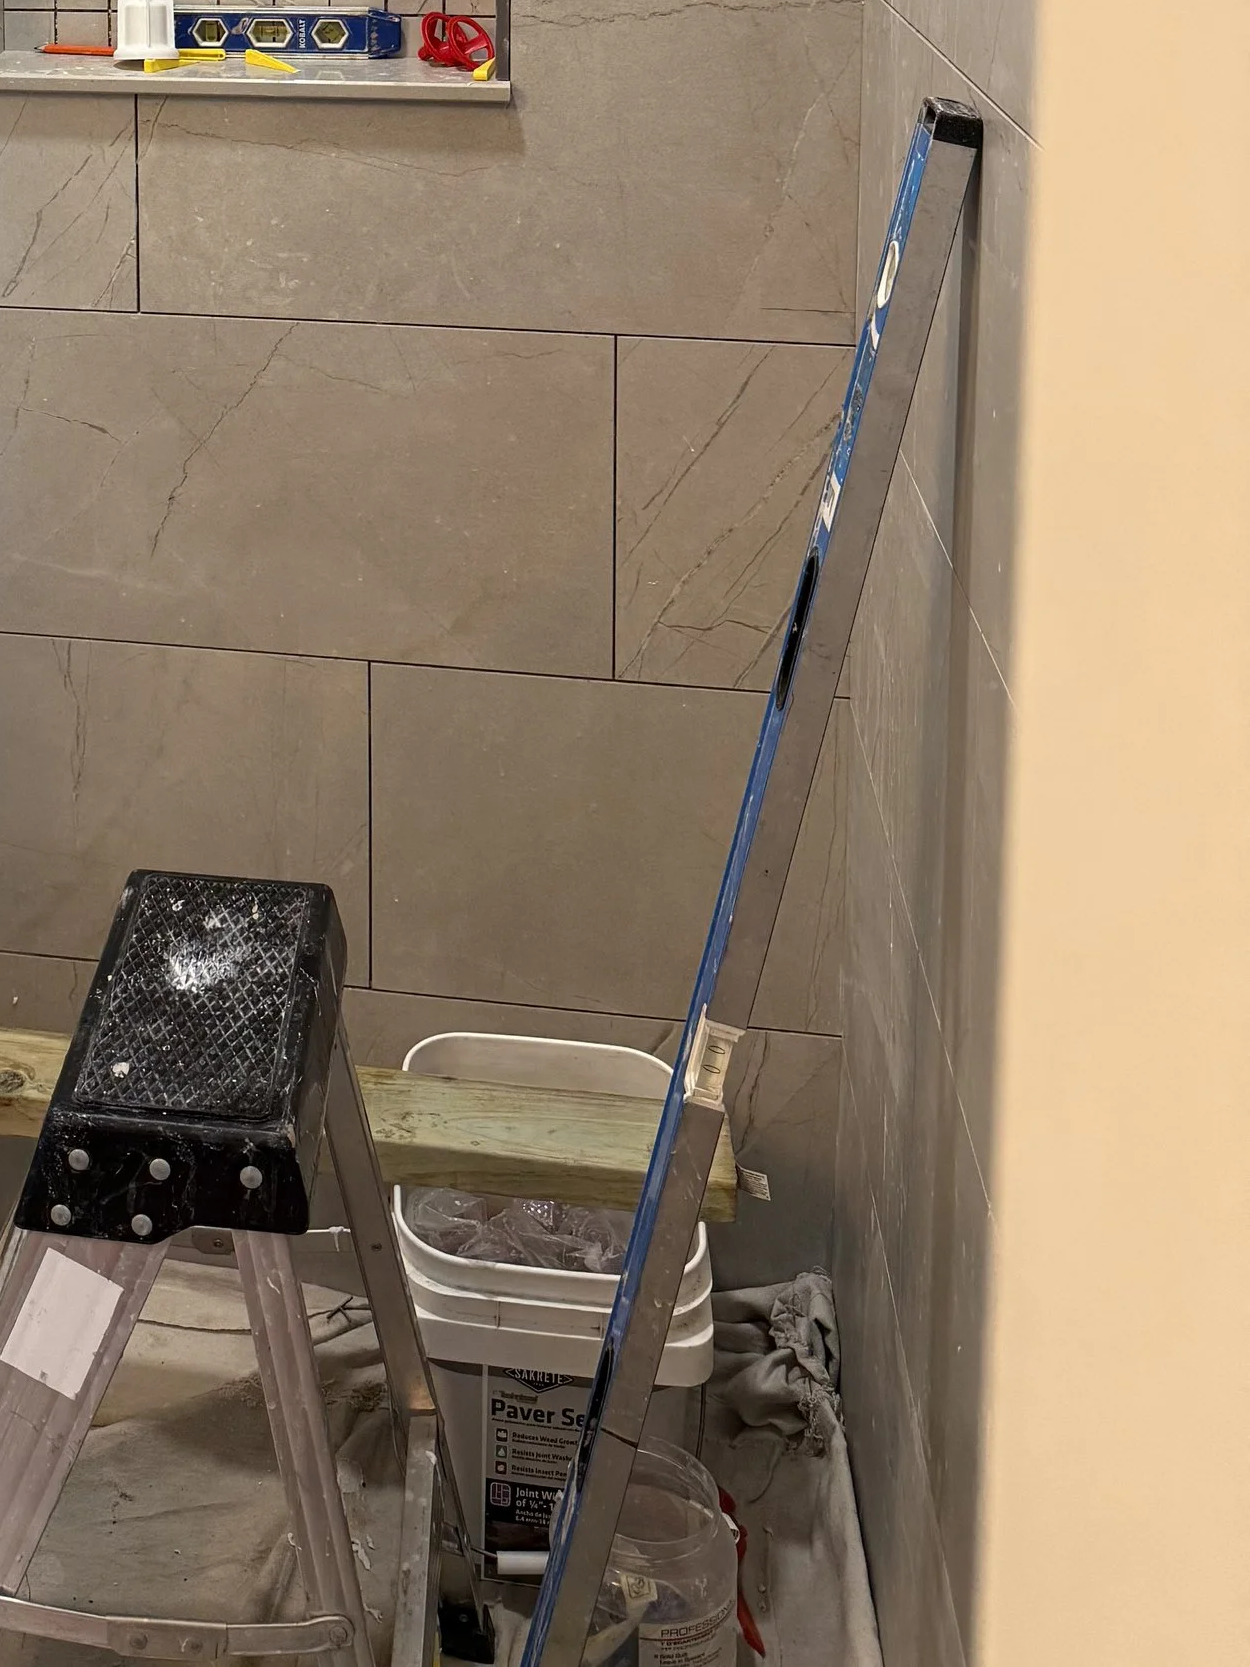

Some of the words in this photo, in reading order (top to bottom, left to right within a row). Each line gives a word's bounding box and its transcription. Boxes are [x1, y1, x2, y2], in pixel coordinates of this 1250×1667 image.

[514, 1368, 564, 1385] SAKRETE
[491, 1397, 556, 1424] Paver
[512, 1432, 538, 1441] Reduces
[539, 1434, 558, 1444] Weed
[511, 1448, 535, 1458] Resists
[535, 1451, 551, 1460] Joint
[511, 1465, 535, 1474] Resists
[535, 1467, 554, 1476] Insect
[516, 1487, 539, 1499] Joint
[515, 1498, 527, 1508] of
